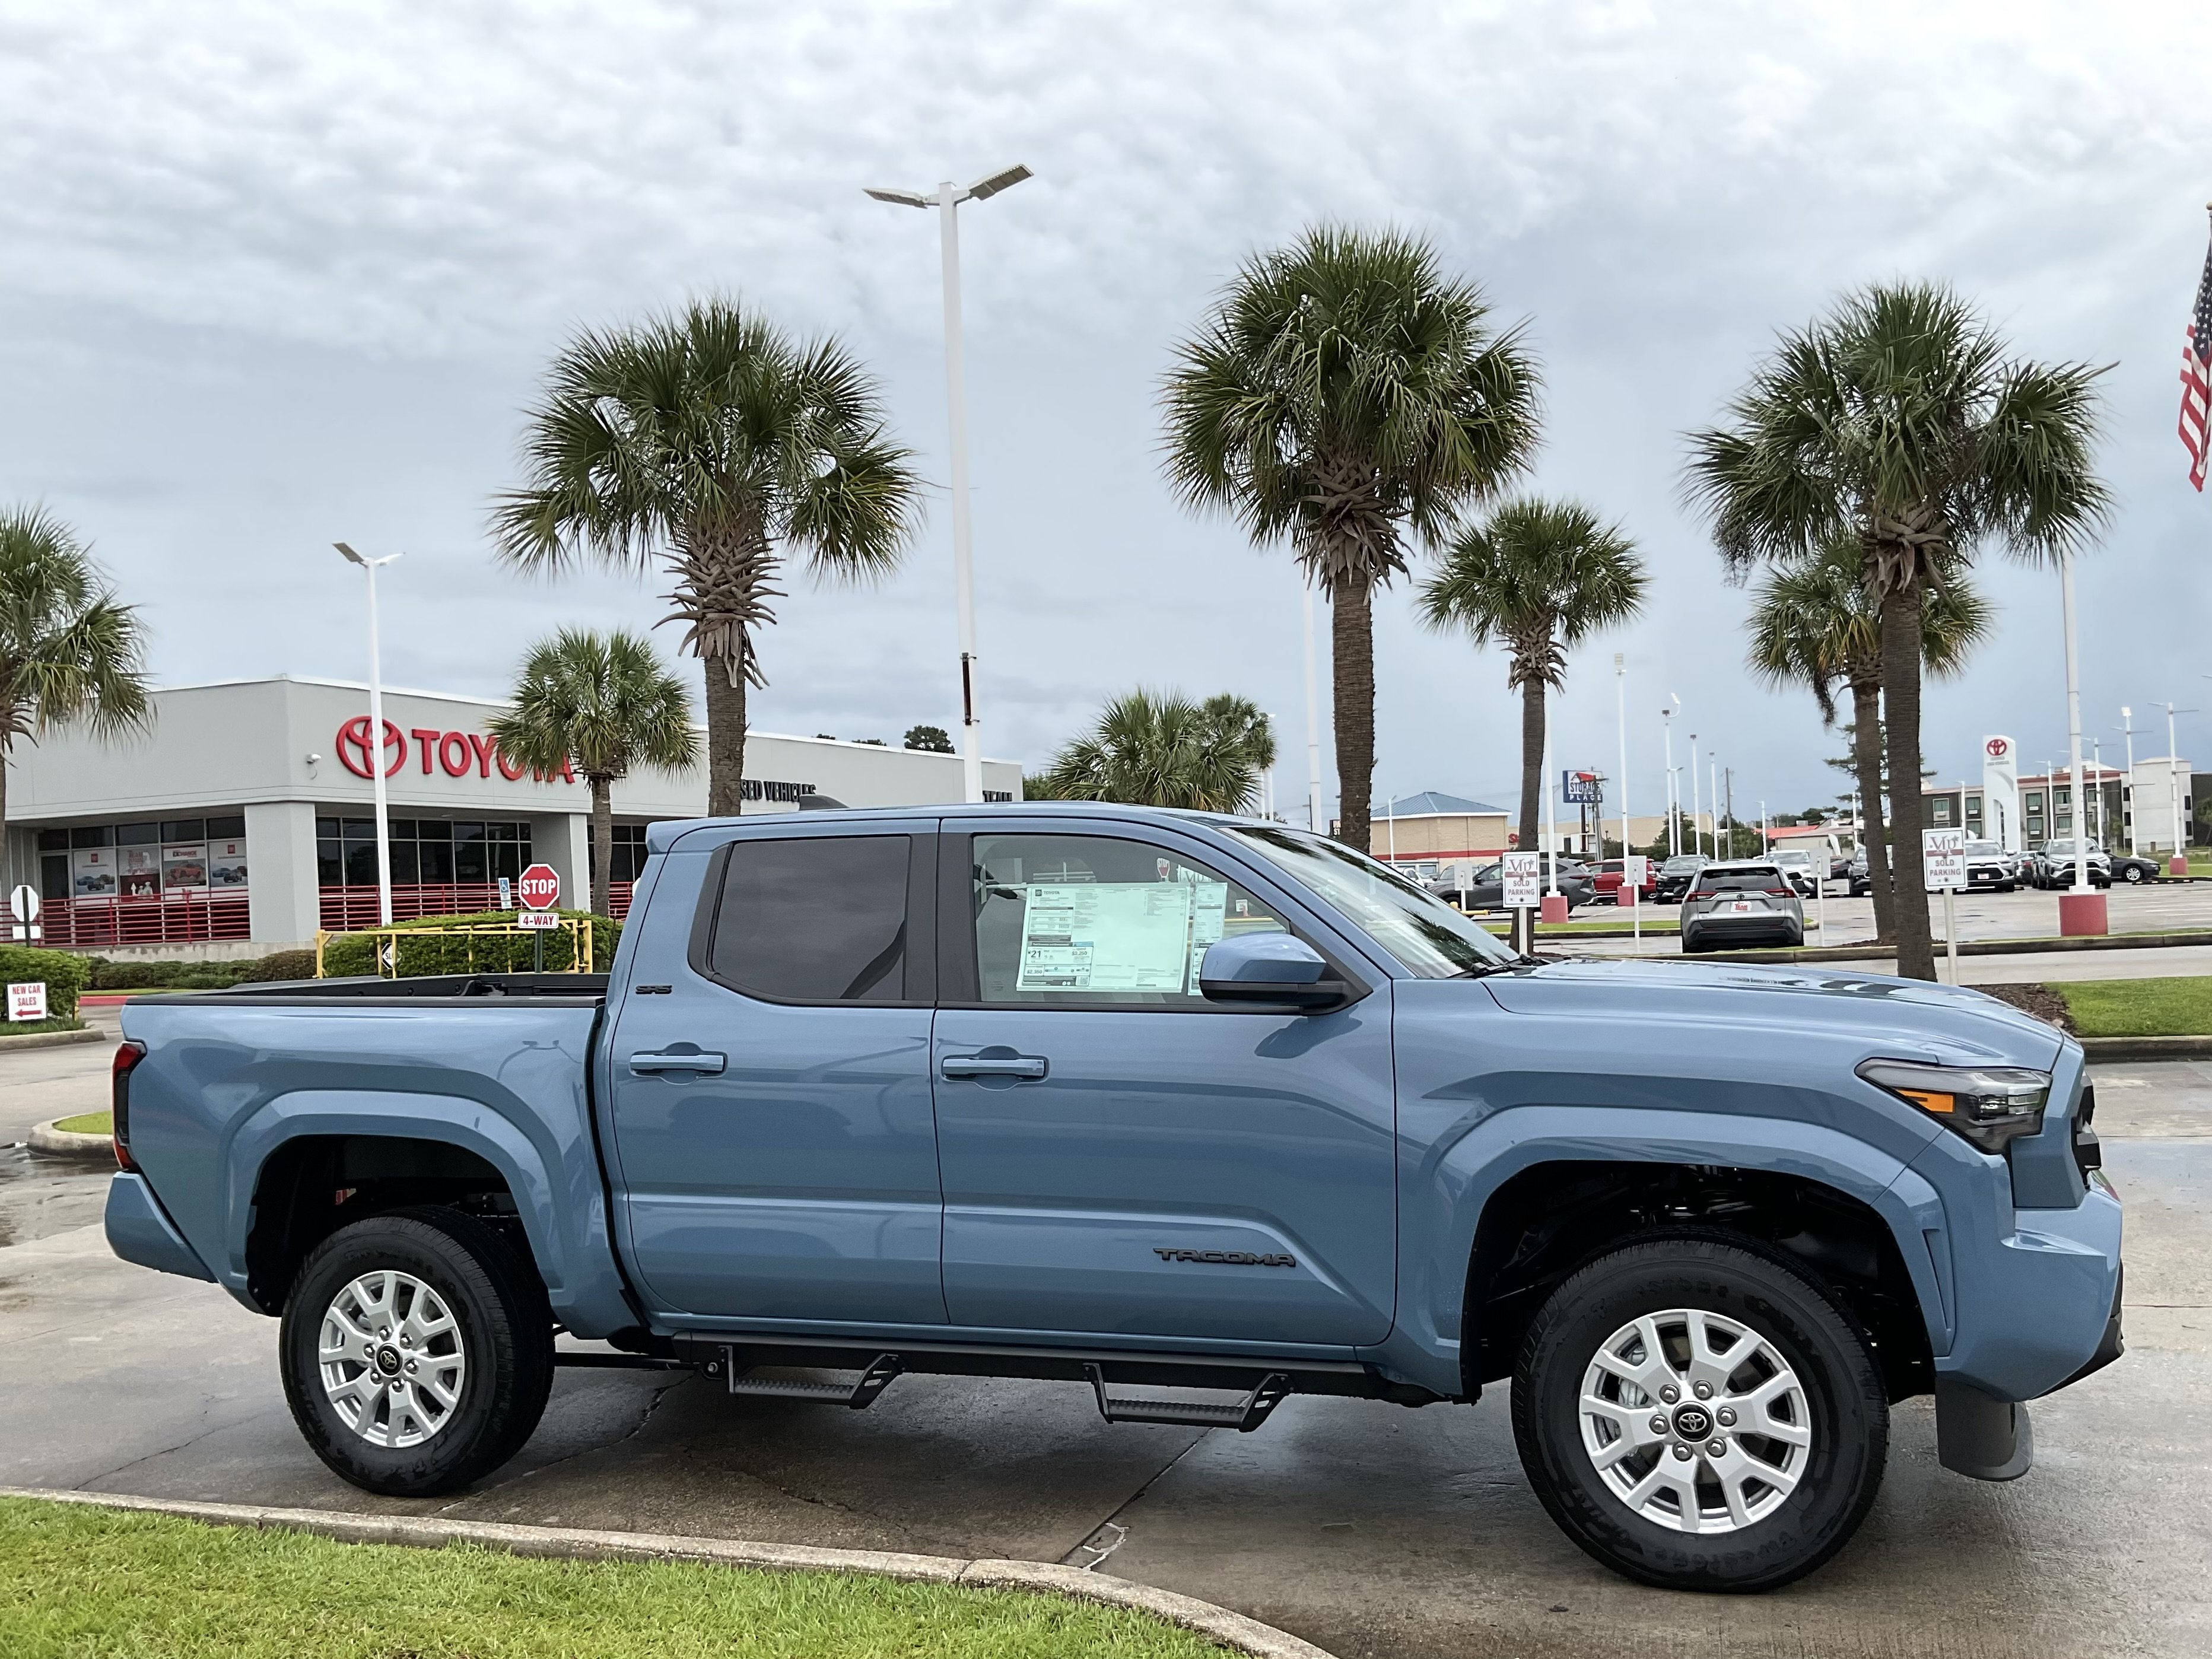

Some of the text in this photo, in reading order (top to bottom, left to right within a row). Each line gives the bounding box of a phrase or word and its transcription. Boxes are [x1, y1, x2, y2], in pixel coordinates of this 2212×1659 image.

[412, 729, 575, 783] TOYO
[740, 779, 762, 800] SED
[1570, 783, 1601, 793] STORA
[522, 879, 557, 895] STOP
[523, 916, 554, 926] 4-WAY
[1031, 950, 1041, 958] 21
[12, 985, 41, 994] NEW CAR
[635, 985, 672, 994] SR5
[17, 997, 37, 1006] SALES
[1153, 1248, 1296, 1267] TACOMA
